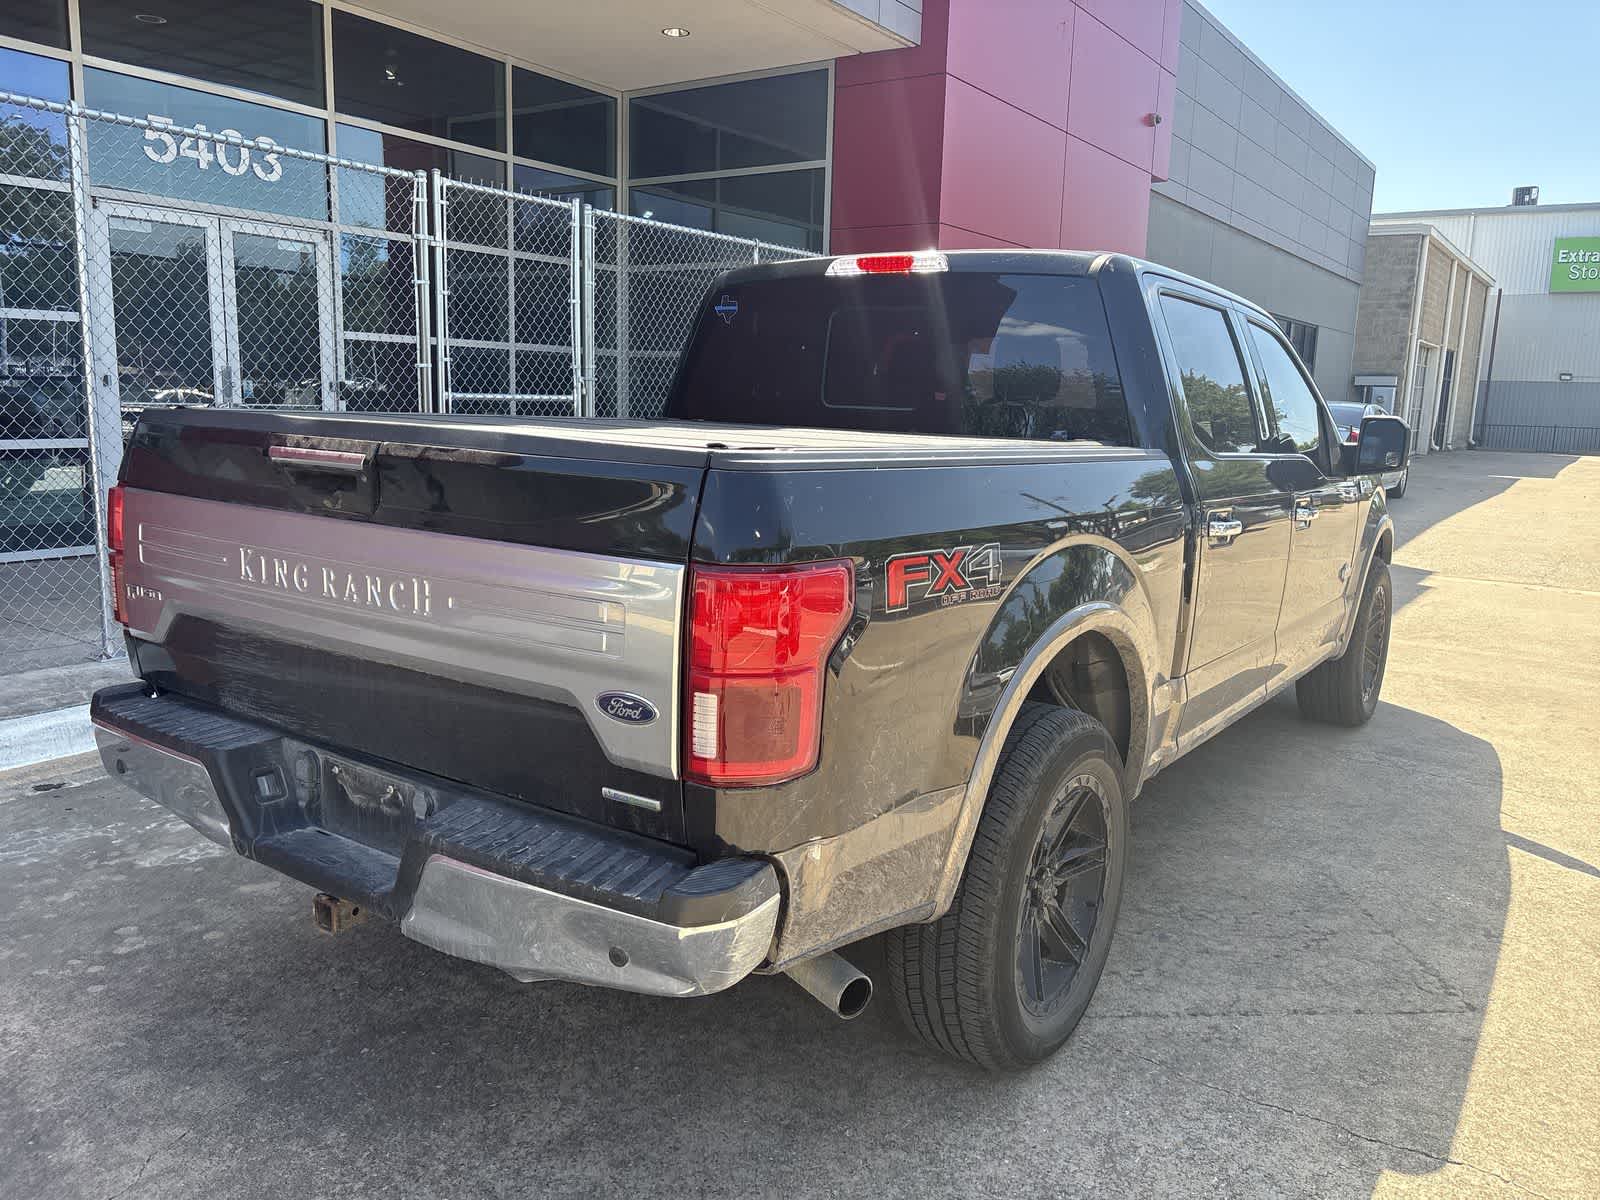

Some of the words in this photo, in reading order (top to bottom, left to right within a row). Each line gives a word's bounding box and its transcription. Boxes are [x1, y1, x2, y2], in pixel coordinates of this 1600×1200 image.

[143, 114, 283, 182] 5403
[1559, 249, 1600, 263] Extra
[1568, 264, 1600, 280] Sto
[239, 547, 308, 593] KING
[321, 566, 433, 617] RANCH
[885, 543, 1003, 613] FX4
[607, 697, 642, 720] Ford
